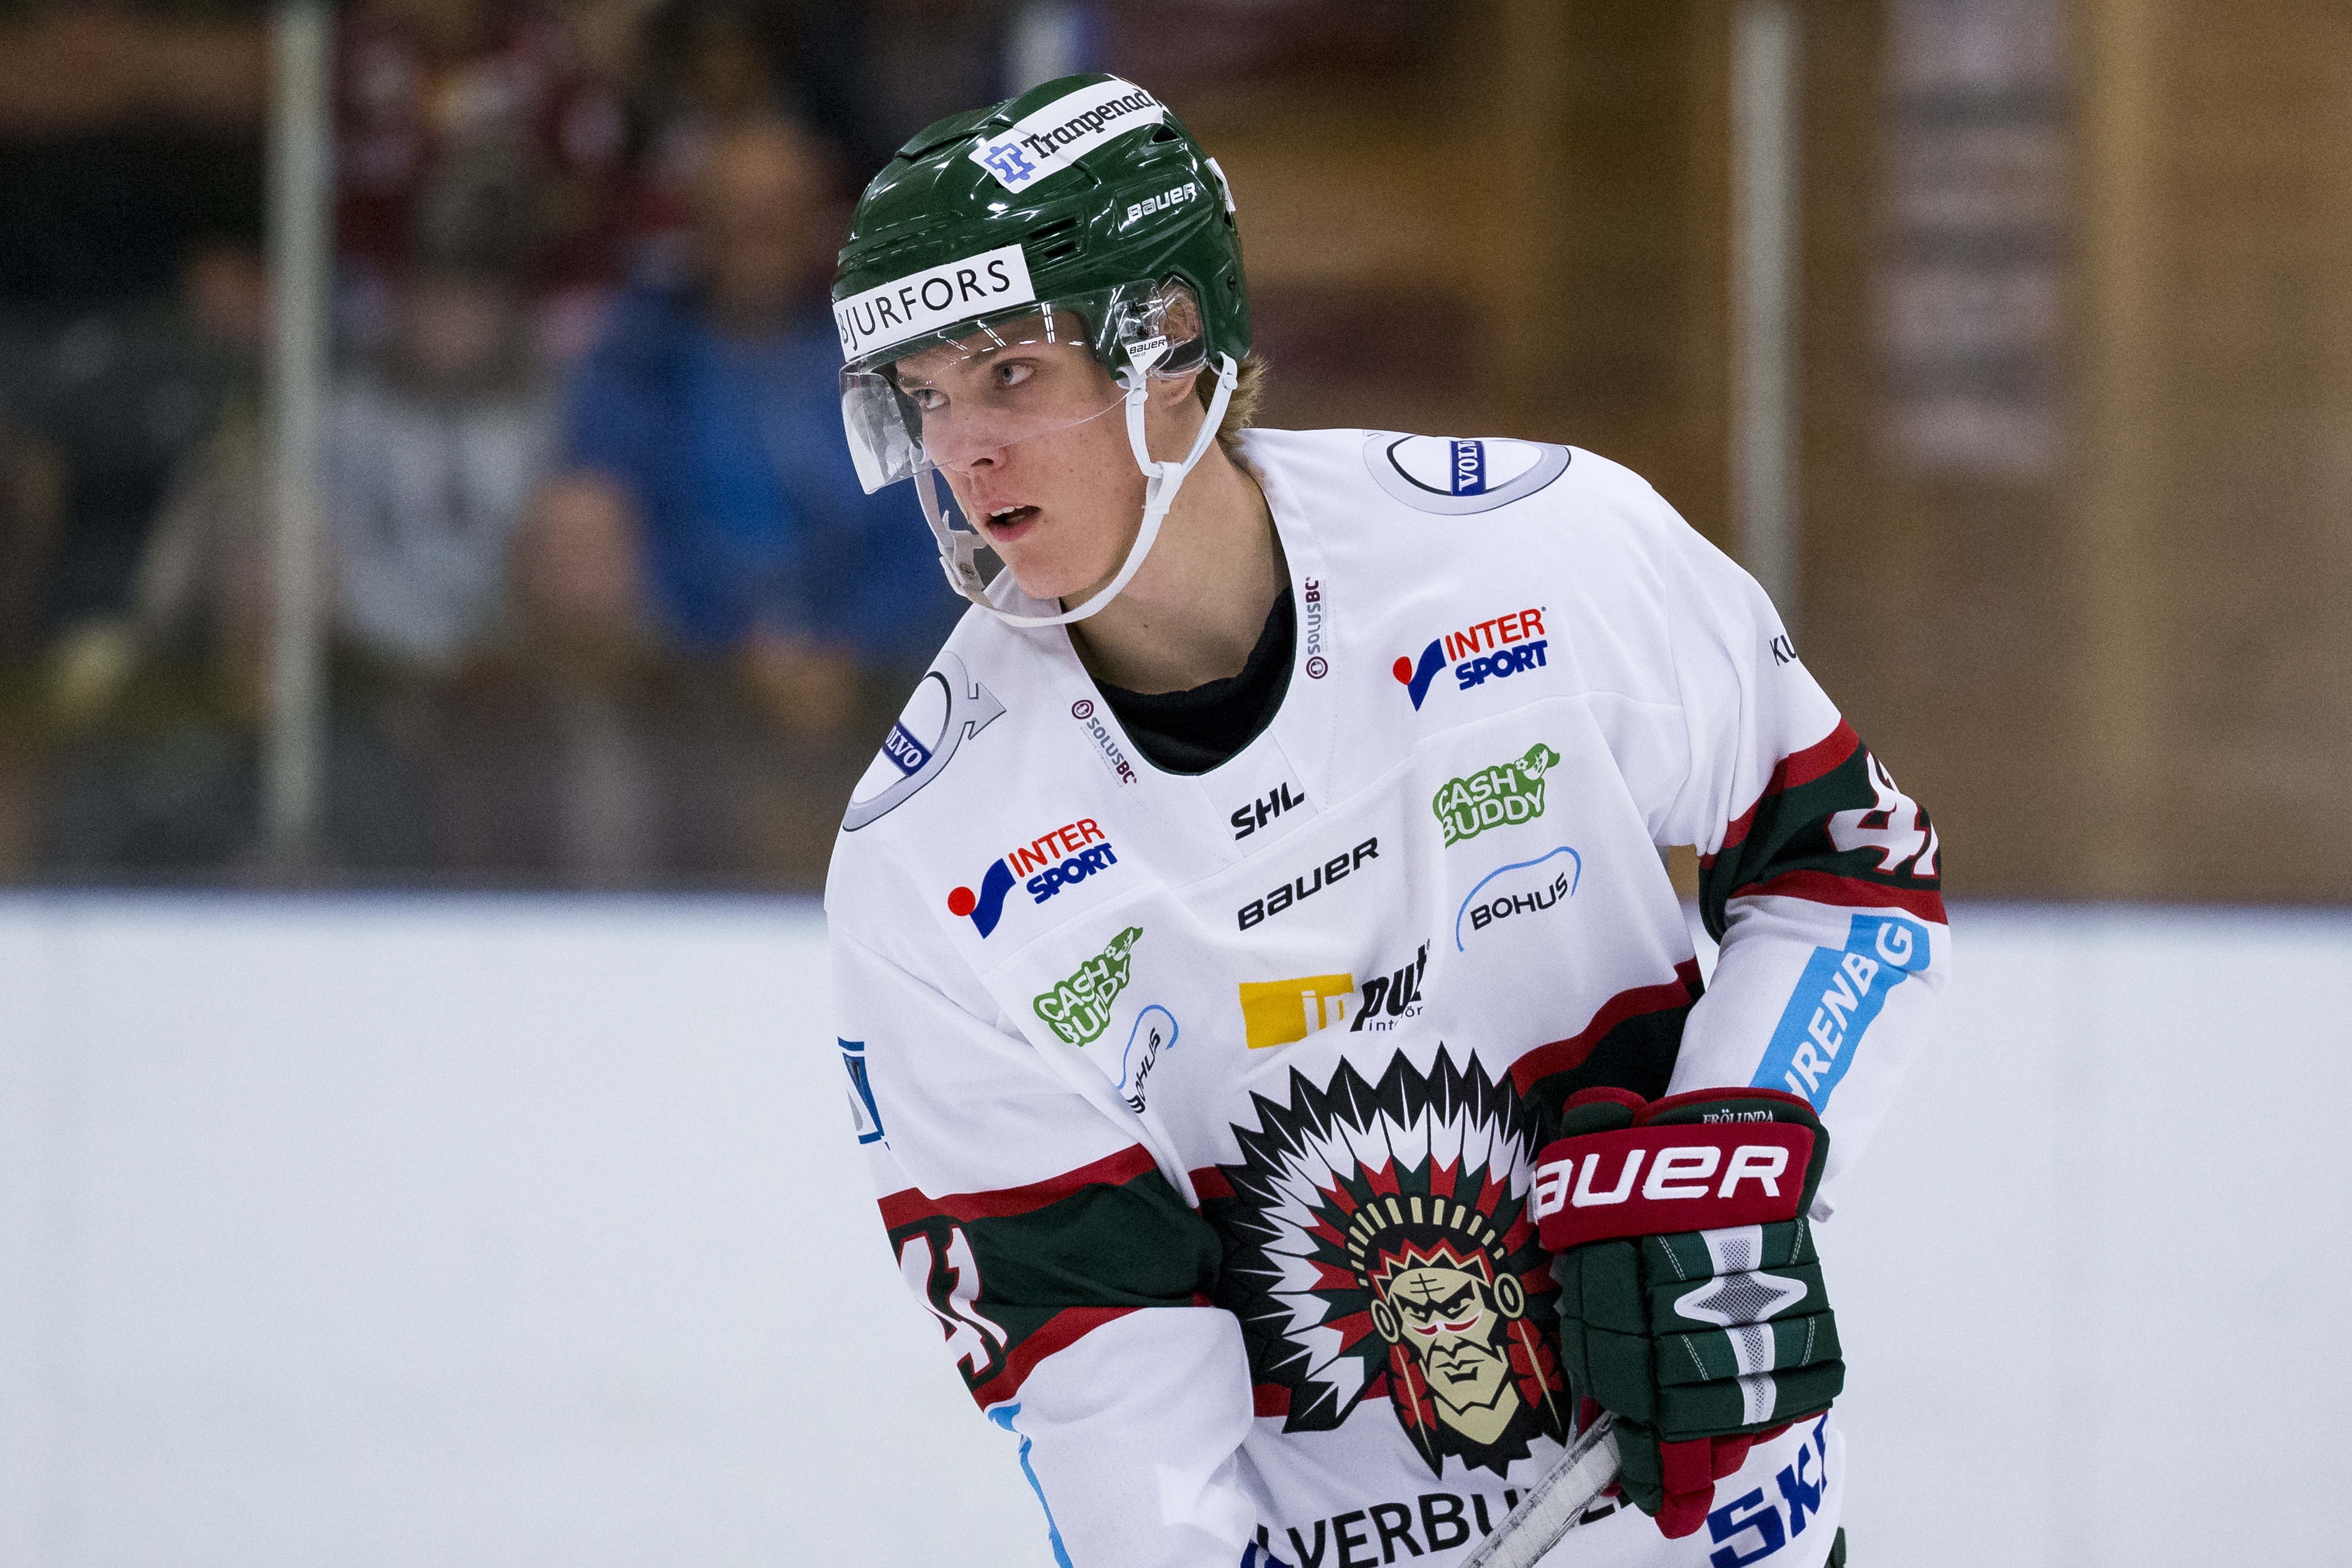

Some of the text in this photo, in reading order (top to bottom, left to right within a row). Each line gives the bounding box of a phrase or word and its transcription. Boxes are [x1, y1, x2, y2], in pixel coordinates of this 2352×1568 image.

[1020, 88, 1156, 159] Tranpenad
[1127, 182, 1197, 222] BAUER
[838, 260, 1010, 352] BJURFORS
[1130, 339, 1164, 355] BAUER
[1457, 441, 1479, 491] VOLV
[1305, 579, 1321, 655] SOLUSBC
[1445, 608, 1545, 661] INTER
[1455, 640, 1549, 691] SPORT
[885, 725, 922, 767] OLVO
[1086, 717, 1135, 784] SOLUSBC
[1230, 782, 1305, 841] SHL
[1438, 768, 1518, 817] CASH
[1443, 784, 1543, 840] BUDDY
[1008, 818, 1105, 878] INTER
[1027, 842, 1118, 905] SPORT
[1238, 836, 1379, 931] BAUER
[1470, 872, 1568, 931] BOHUS
[1039, 959, 1109, 1021] CASH
[1055, 959, 1128, 1044] BUDDY
[1125, 1026, 1161, 1114] BOHUS
[1529, 1145, 1789, 1224] AUER
[1707, 1411, 1827, 1568] SK
